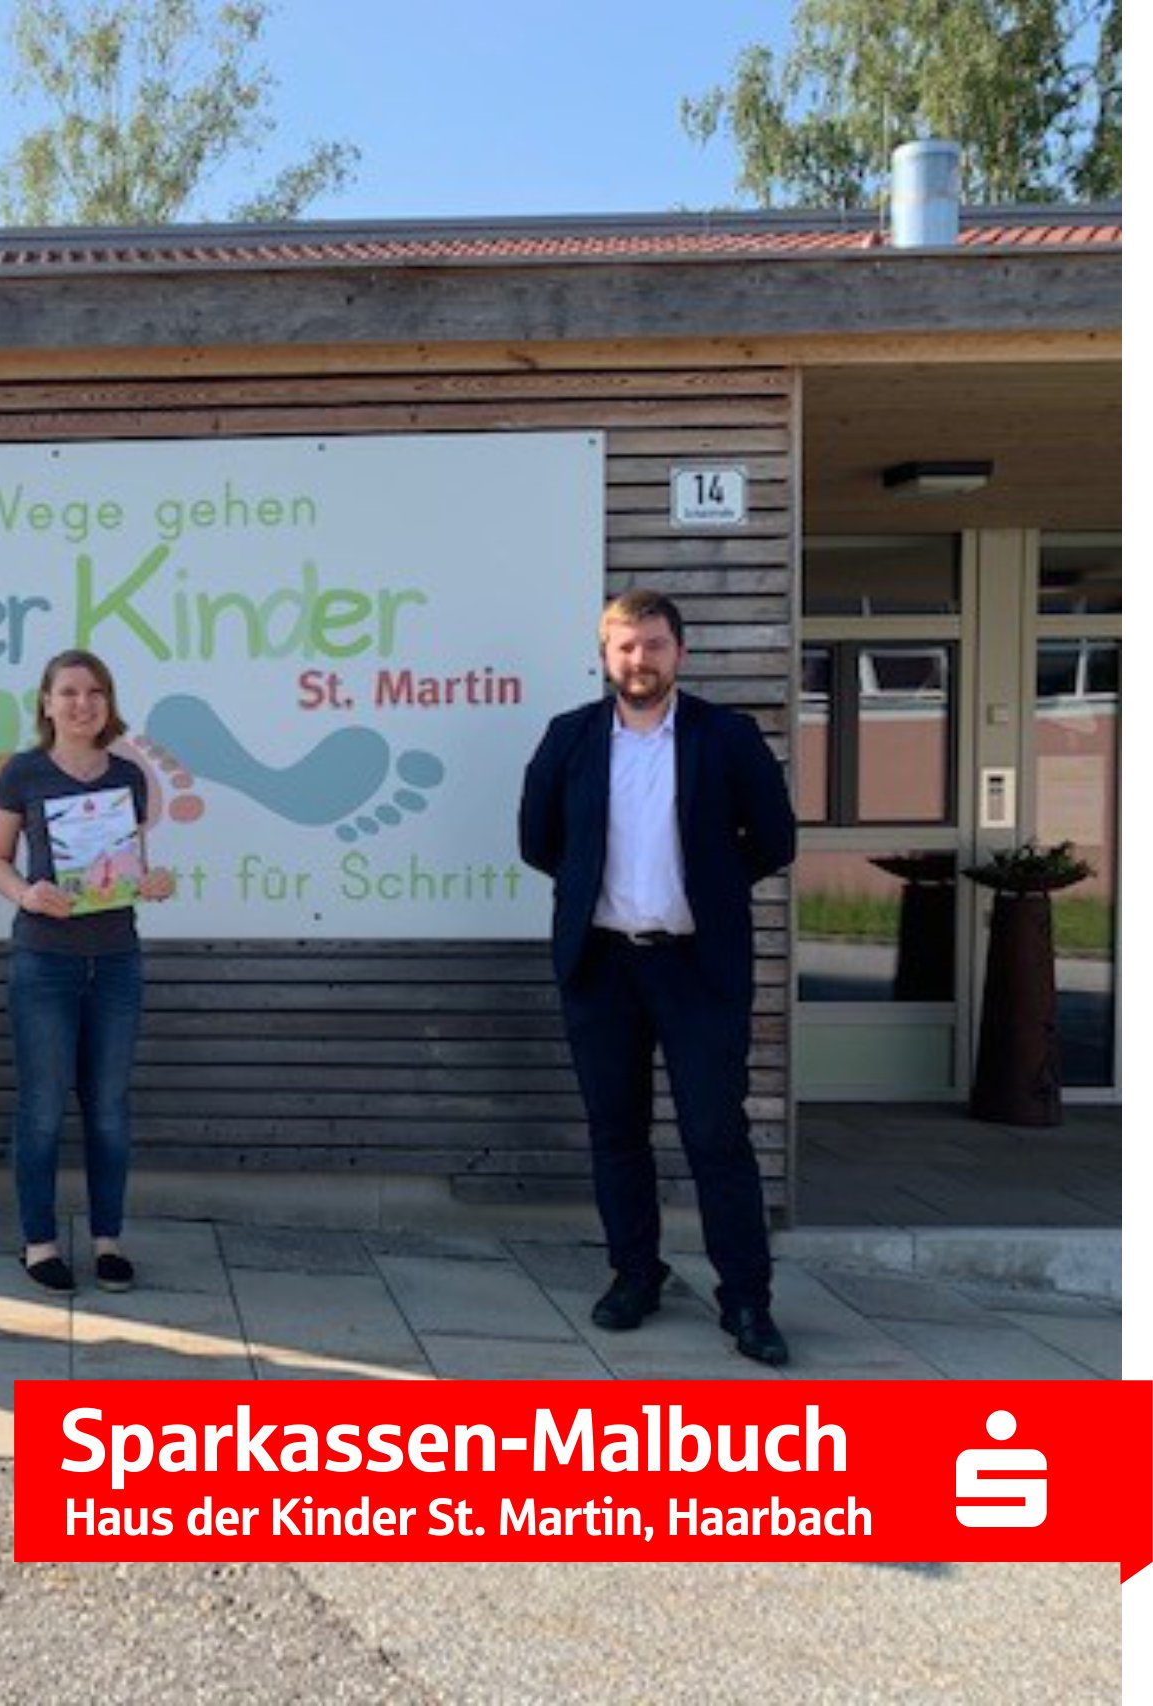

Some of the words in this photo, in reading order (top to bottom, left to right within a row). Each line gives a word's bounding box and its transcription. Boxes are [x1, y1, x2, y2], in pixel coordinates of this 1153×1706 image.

[156, 482, 317, 541] gehen
[694, 474, 724, 505] 14
[75, 544, 429, 661] Kinder
[298, 669, 353, 709] St.
[375, 667, 522, 706] Martin
[237, 853, 312, 900] für
[340, 852, 522, 900] Schritt
